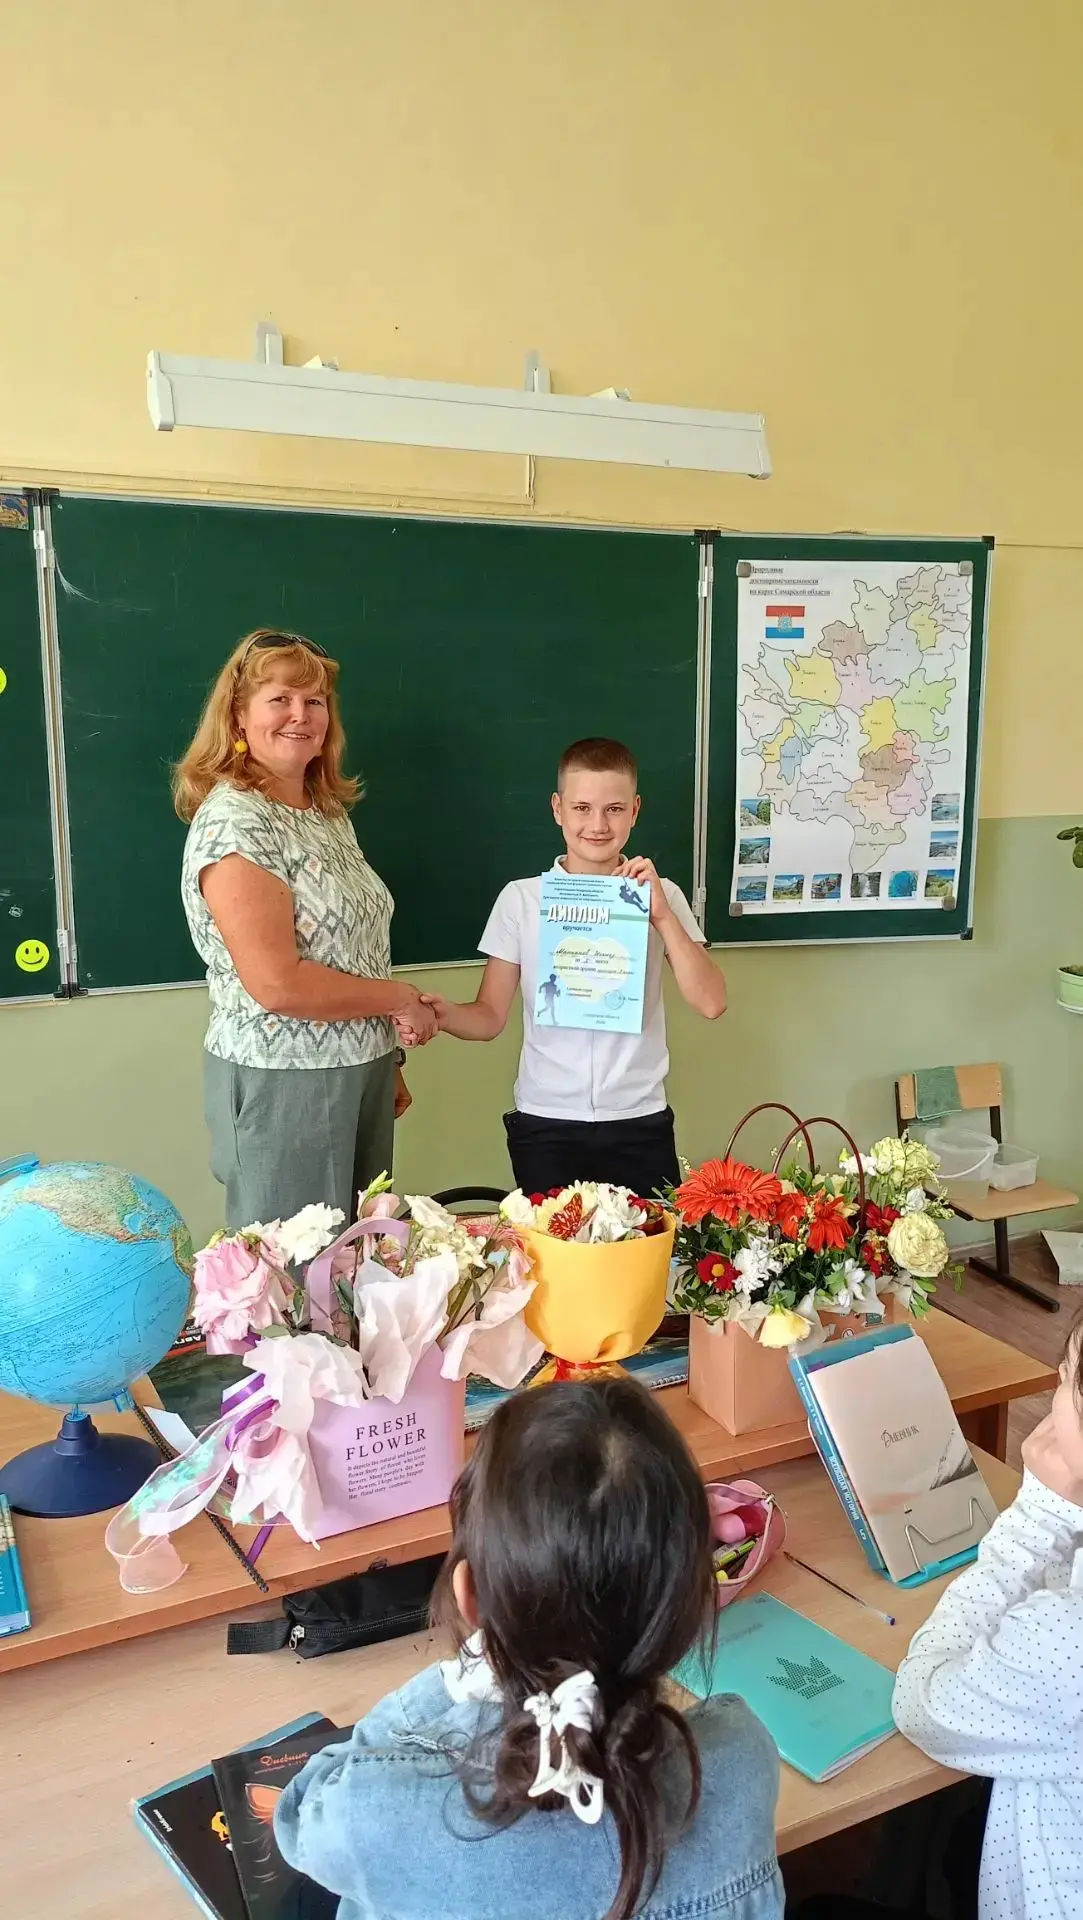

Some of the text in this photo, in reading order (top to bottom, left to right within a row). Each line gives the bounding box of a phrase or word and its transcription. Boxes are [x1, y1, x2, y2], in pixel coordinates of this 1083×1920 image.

[547, 903, 611, 925] ДИПЛОМ
[356, 1412, 417, 1440] FRESH
[346, 1428, 427, 1461] FLOWER
[828, 1455, 860, 1521] ВСЕОБЩАЯ ИСТОРИЯ
[260, 1751, 308, 1766] Дневник
